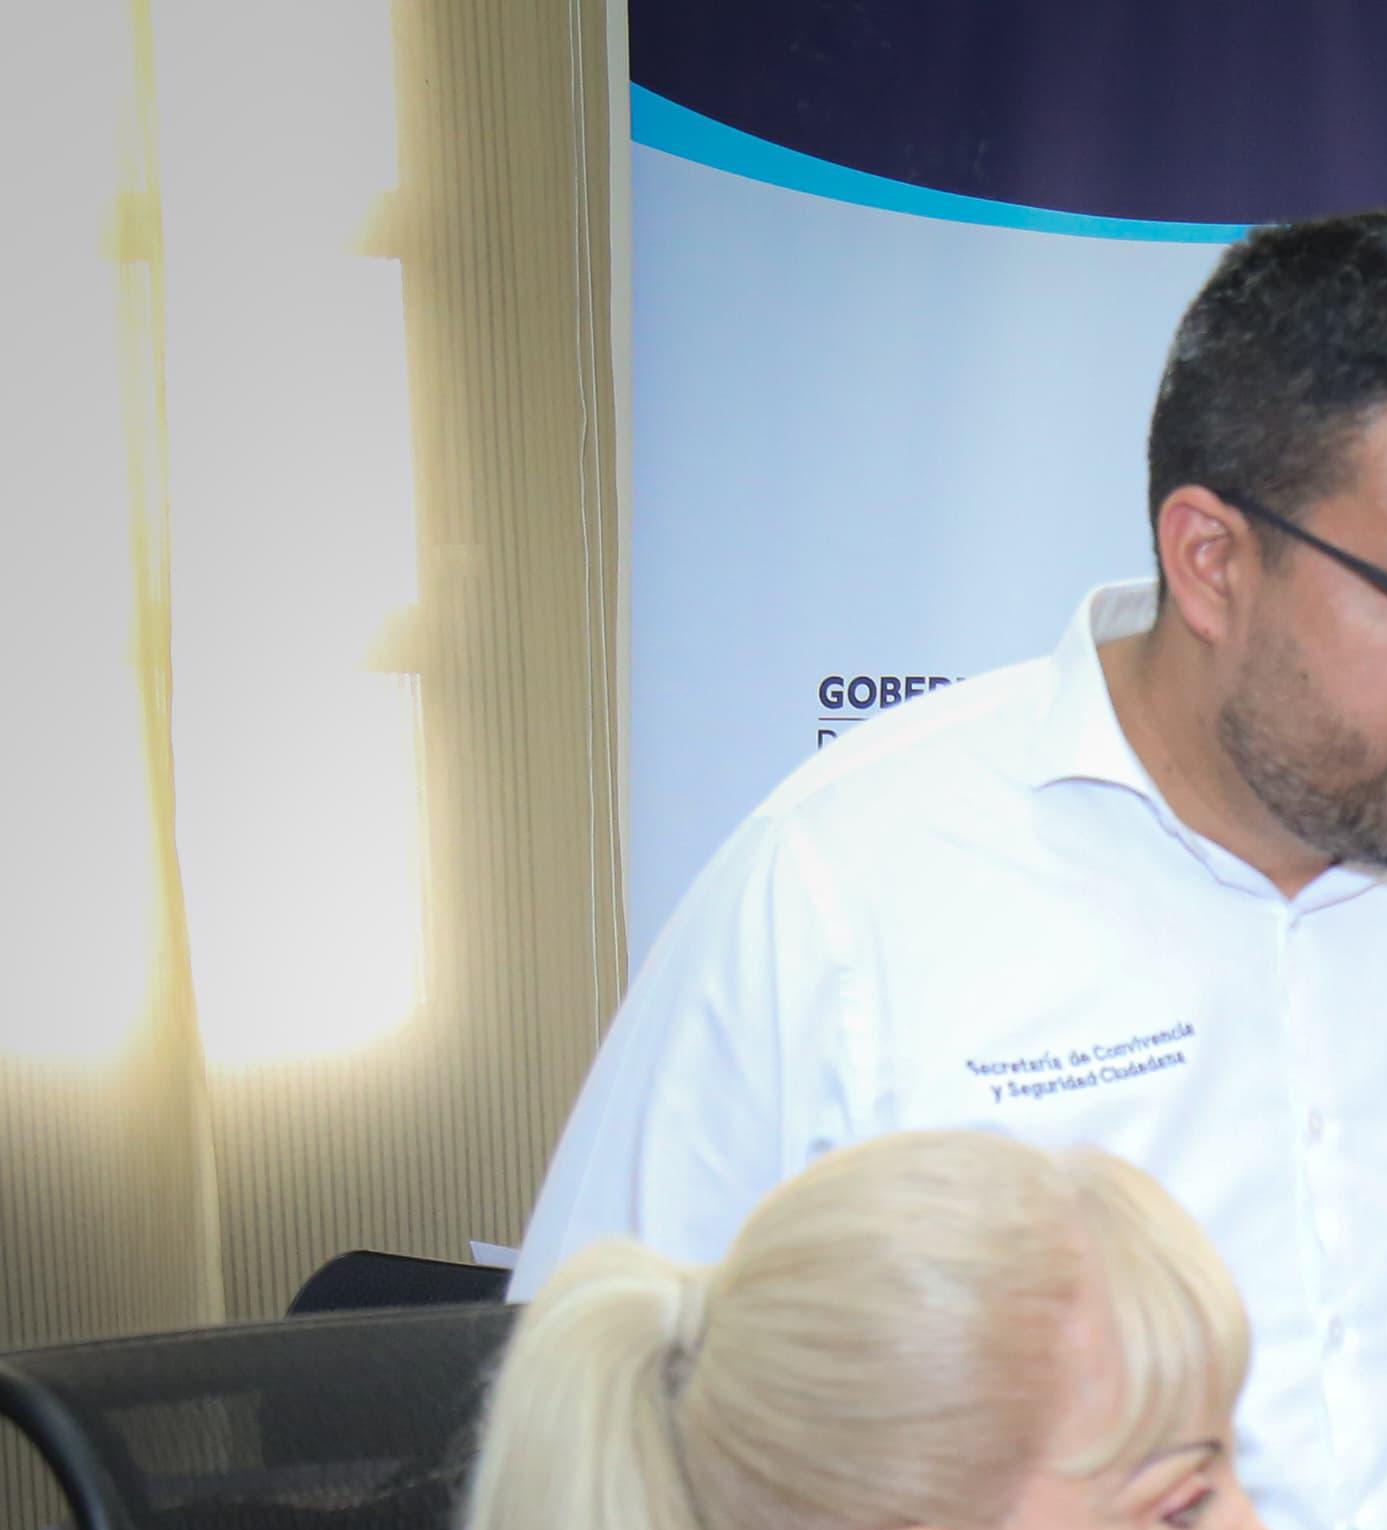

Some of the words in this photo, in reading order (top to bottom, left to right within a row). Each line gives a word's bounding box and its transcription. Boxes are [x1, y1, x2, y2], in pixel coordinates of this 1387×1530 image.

[966, 1050, 1062, 1076] Secretaría
[1068, 1049, 1091, 1067] de
[1093, 1021, 1196, 1061] Convivencia
[991, 1084, 1002, 1104] y
[1007, 1071, 1097, 1100] Seguridad
[1099, 1050, 1187, 1083] Ciudadana
